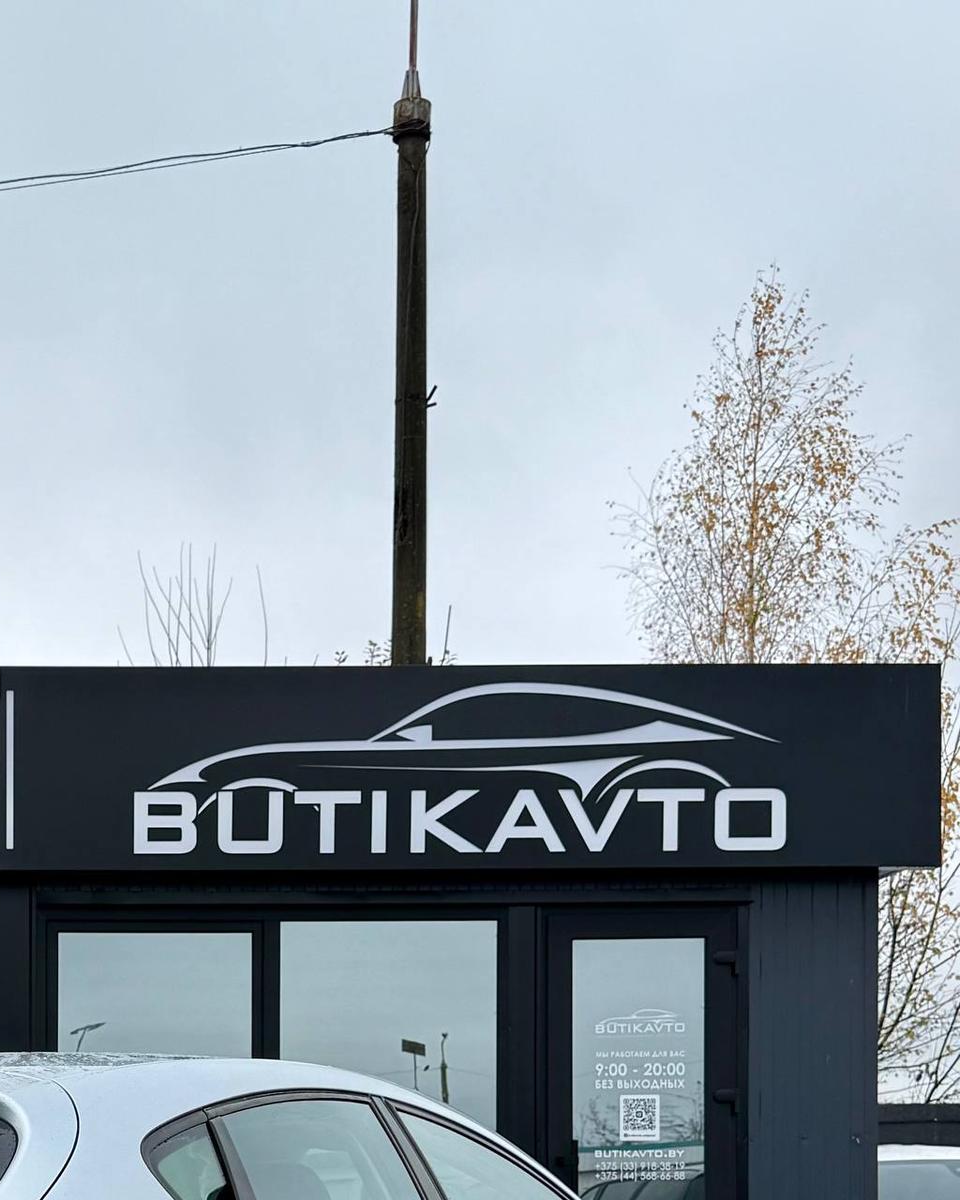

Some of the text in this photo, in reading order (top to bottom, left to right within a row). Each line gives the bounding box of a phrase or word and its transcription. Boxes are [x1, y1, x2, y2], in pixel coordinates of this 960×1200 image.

[133, 787, 787, 854] BUTIKAVTO
[595, 1023, 685, 1034] BUTIKAVTO
[595, 1063, 627, 1076] 9:00
[643, 1062, 685, 1076] 20:00
[595, 1079, 685, 1090] БЕЗ ВЫХОДНЫХ
[594, 1149, 685, 1158] BUTIKAVTO.BY
[595, 1161, 686, 1172] +375 (33) 918-38-19
[595, 1171, 686, 1182] +375 (44) 568-66-88
